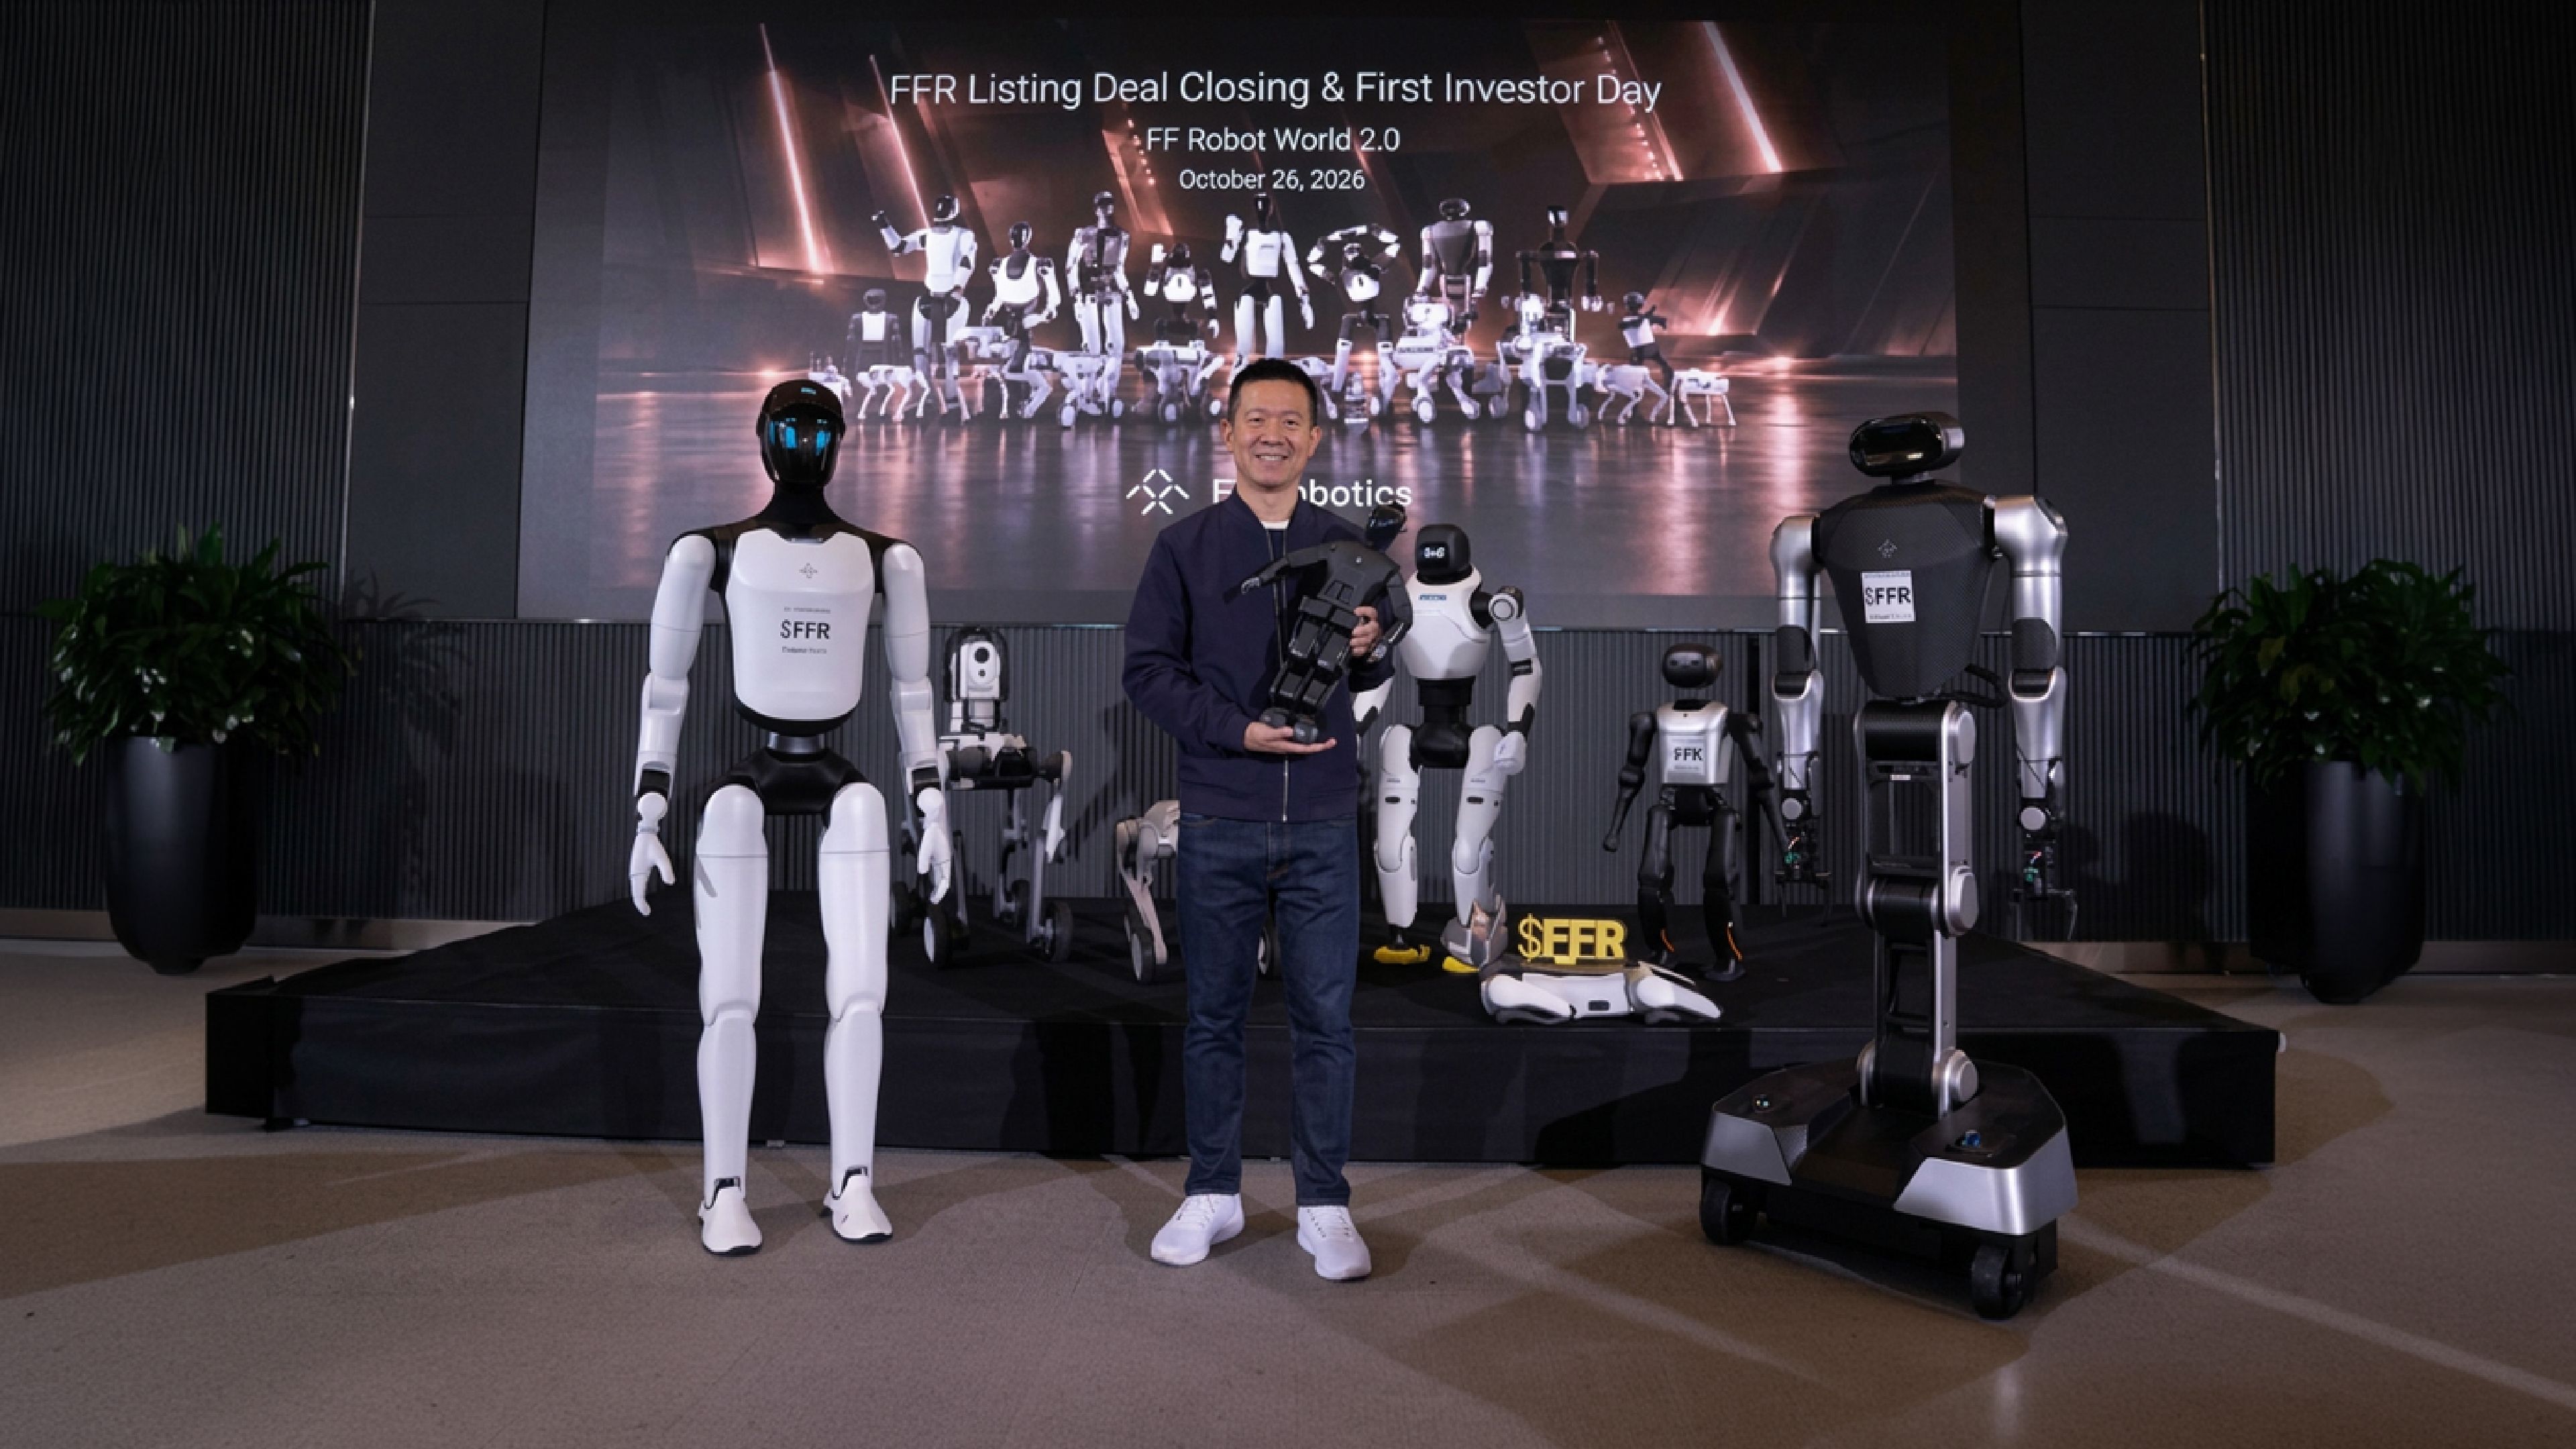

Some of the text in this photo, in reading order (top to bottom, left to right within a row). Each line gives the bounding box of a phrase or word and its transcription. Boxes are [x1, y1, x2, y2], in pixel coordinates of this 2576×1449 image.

[890, 71, 1662, 112] FFR Listing Deal Closing & First Investor Day
[1148, 127, 1401, 152] FF Robot World 2.0
[1180, 169, 1366, 194] October 26, 2026
